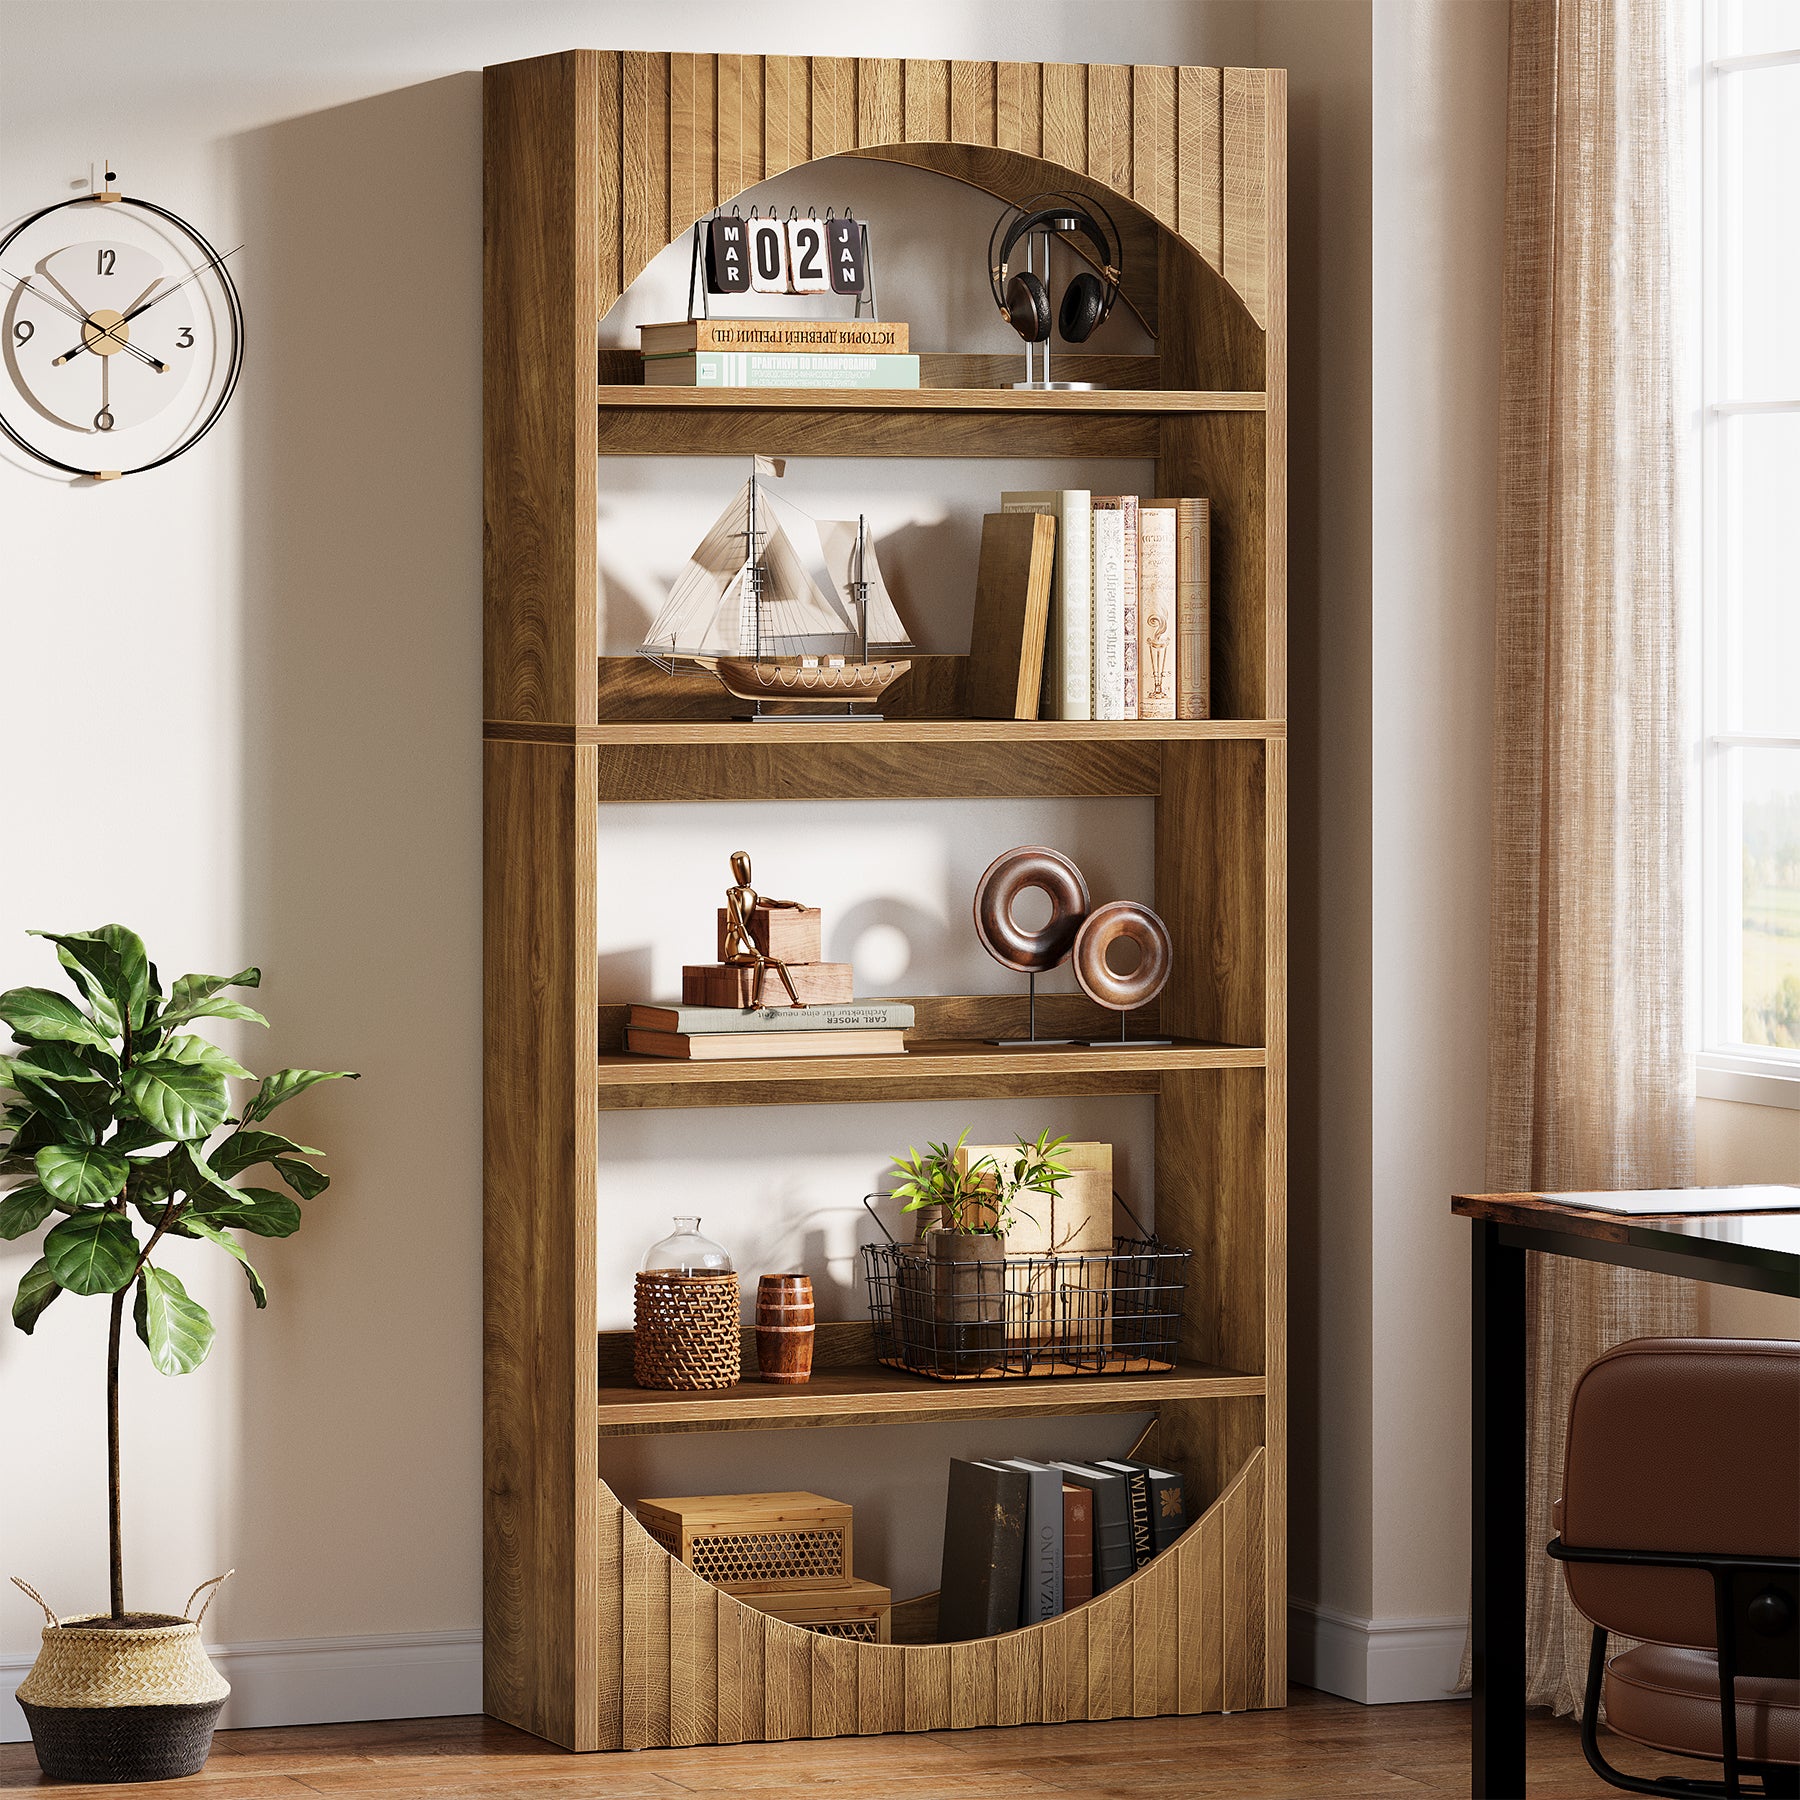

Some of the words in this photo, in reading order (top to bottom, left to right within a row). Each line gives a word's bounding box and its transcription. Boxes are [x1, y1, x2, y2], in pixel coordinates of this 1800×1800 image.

[724, 226, 740, 281] MAR
[838, 228, 856, 283] JAN
[97, 249, 117, 276] 12
[13, 320, 35, 348] 9
[175, 326, 195, 349] 3
[737, 329, 783, 344] ГРЕЦИИ
[785, 329, 838, 345] ДРЕВНЕЙ
[839, 331, 895, 345] ИСТОРИЯ
[752, 356, 799, 370] ПРАКТИКУМ
[799, 357, 811, 370] ПО
[811, 357, 877, 371] ПЛАНИРОВАНИЮ
[93, 403, 114, 431] 6
[757, 1011, 775, 1019] Zeit
[822, 1010, 836, 1018] für
[826, 1016, 859, 1024] MOSER
[838, 1009, 888, 1018] Architektur
[863, 1016, 887, 1024] CARL
[1130, 1473, 1150, 1553] WILLIAM
[1136, 1557, 1151, 1570] S
